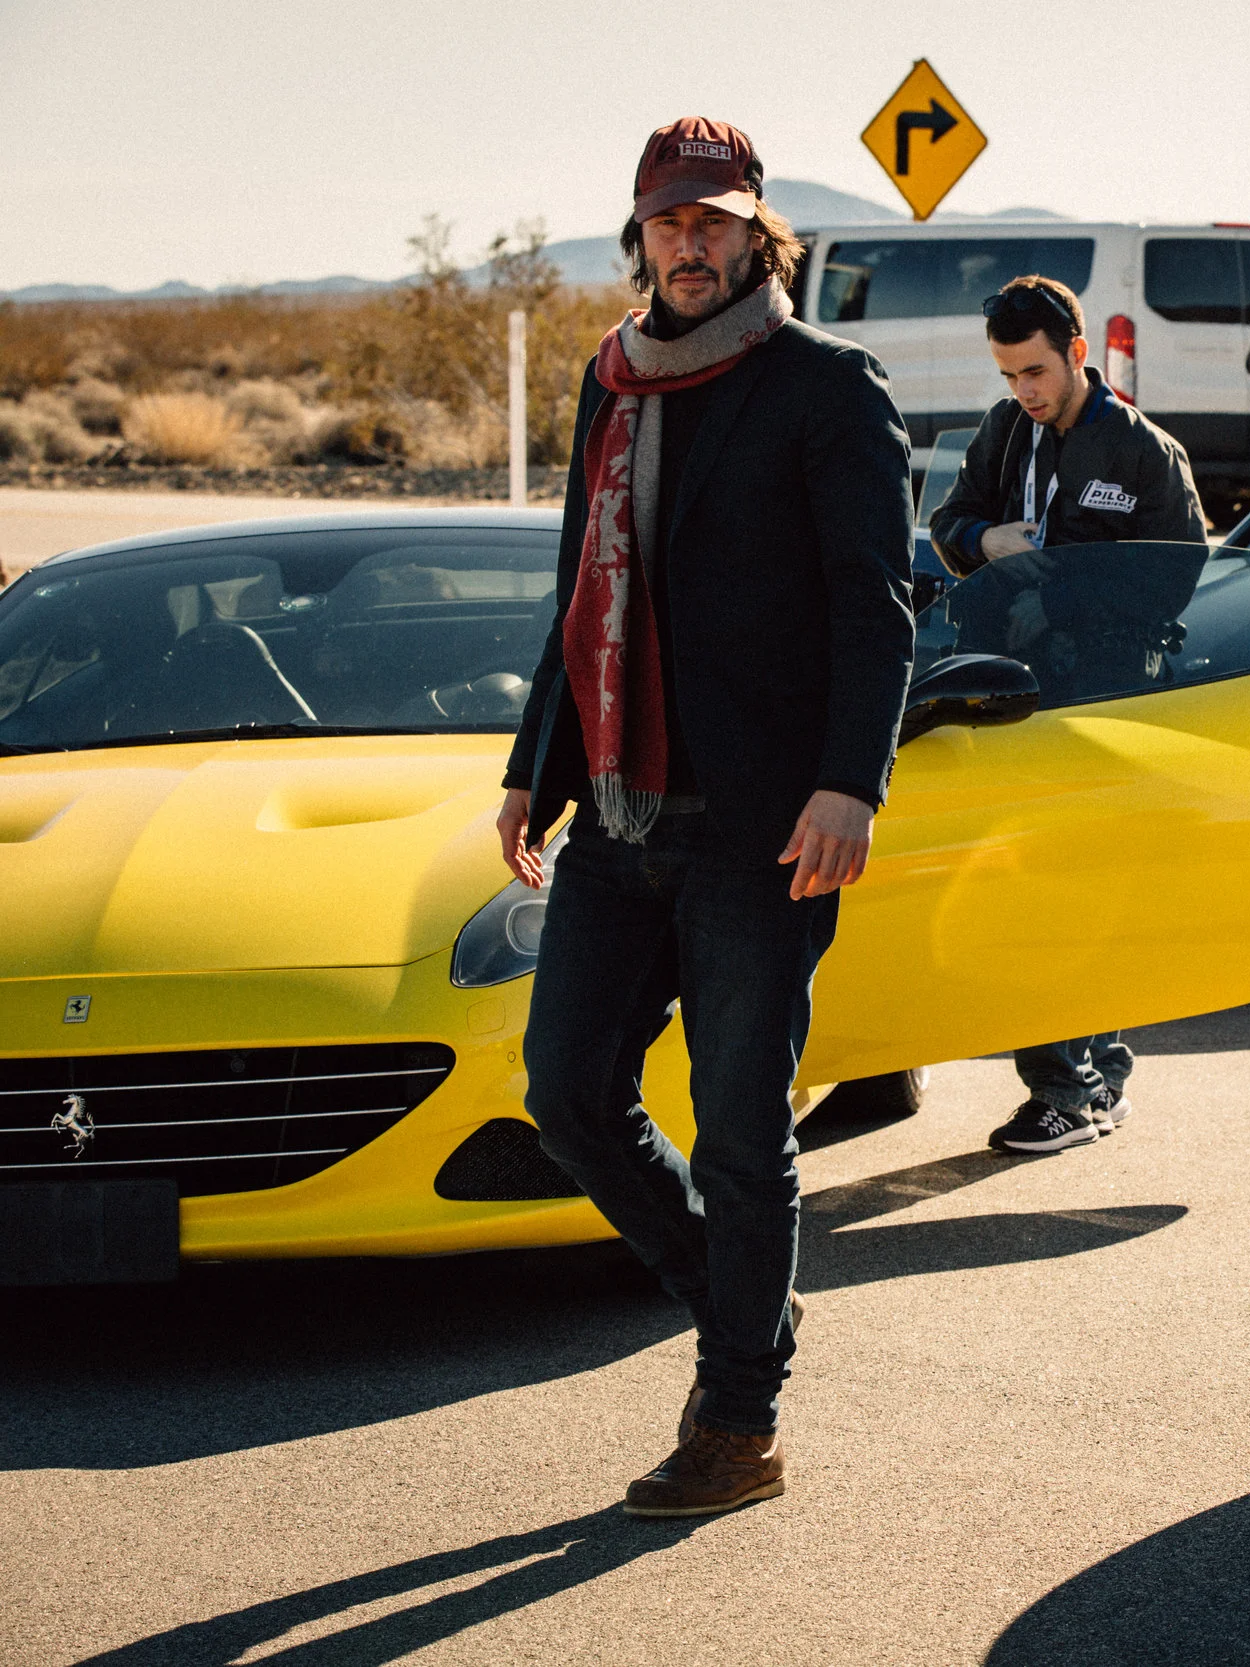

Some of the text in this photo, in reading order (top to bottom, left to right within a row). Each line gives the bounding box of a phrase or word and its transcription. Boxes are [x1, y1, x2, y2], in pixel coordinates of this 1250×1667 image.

[682, 143, 729, 158] ARCH
[1088, 498, 1132, 510] EXPERIENCE
[1091, 490, 1136, 505] PILOT
